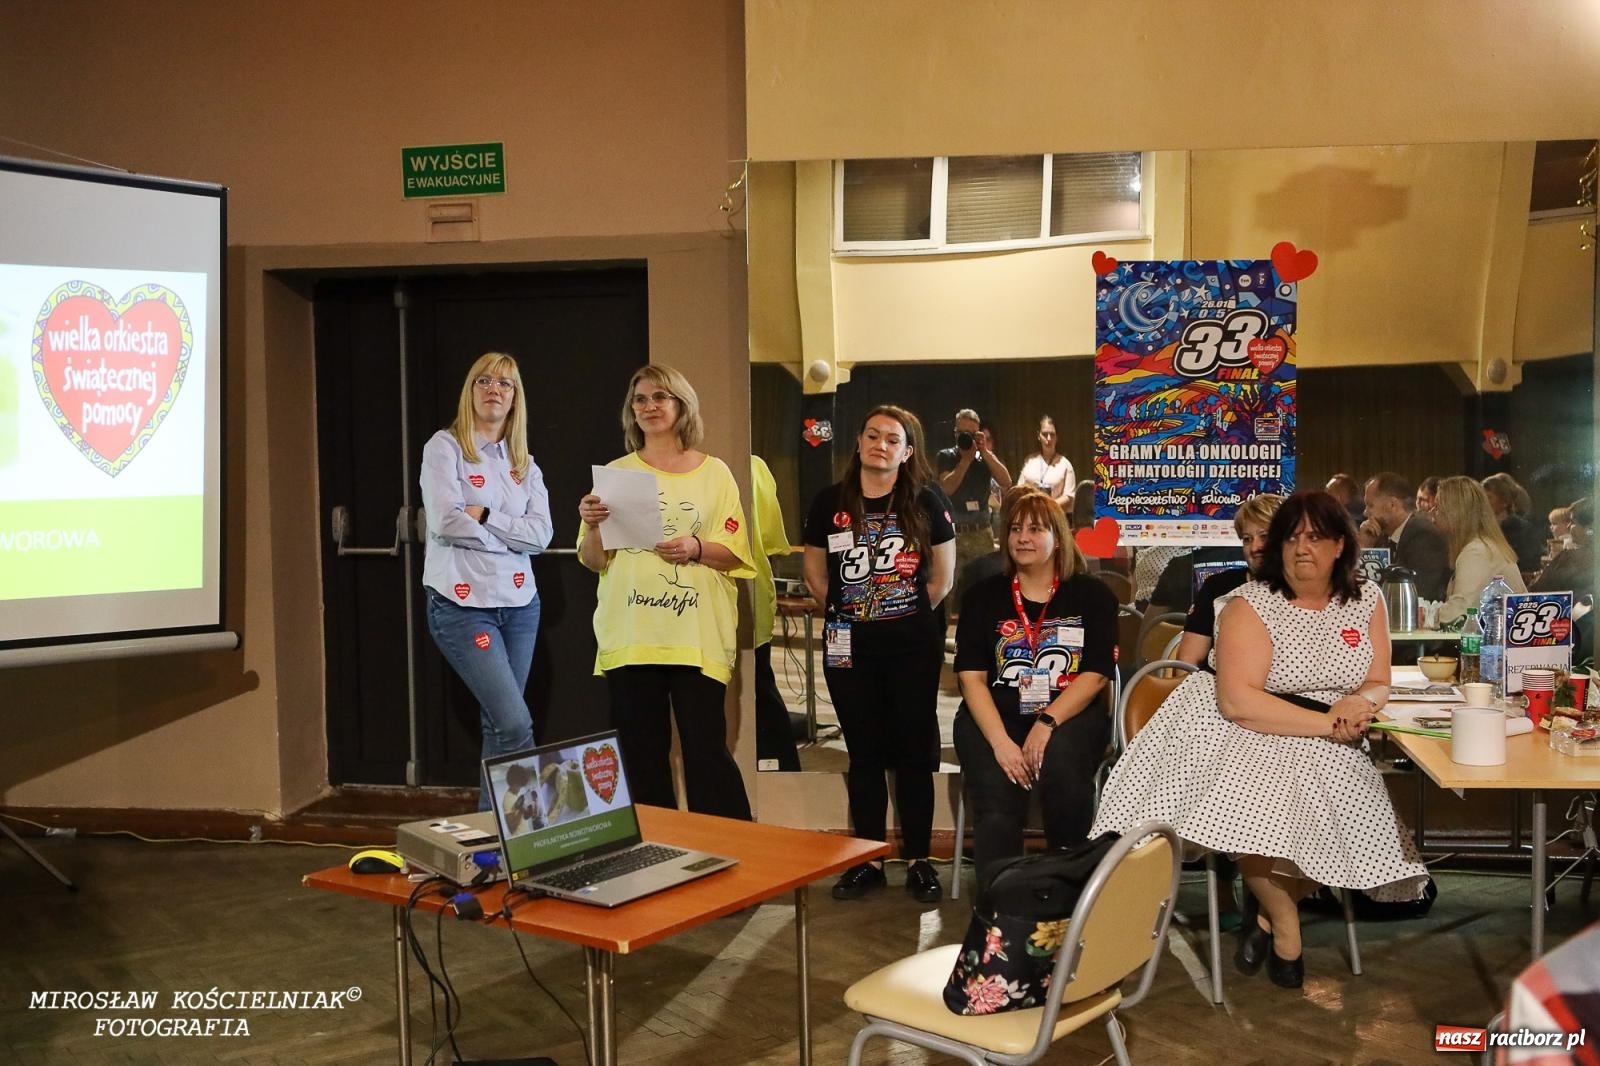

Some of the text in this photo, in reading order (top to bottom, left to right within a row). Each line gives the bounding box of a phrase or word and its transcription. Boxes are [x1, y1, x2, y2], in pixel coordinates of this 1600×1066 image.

[410, 150, 496, 172] WYJŚCIE
[407, 173, 501, 189] EWAKUACYJNE
[49, 315, 168, 355] wielka orkiestra
[1177, 312, 1265, 374] 33
[63, 357, 157, 405] świątecznej
[1216, 367, 1260, 379] FINAŁ
[82, 402, 144, 436] pomocy
[1109, 444, 1282, 460] GRAMY DLA ONKOLOGII
[1117, 464, 1205, 478] HEMATOLOGII
[1209, 465, 1281, 480] DZIECIĘCEJ
[1107, 486, 1188, 513] bezpieczeństwo
[844, 536, 904, 580] 33
[1510, 604, 1559, 641] 33
